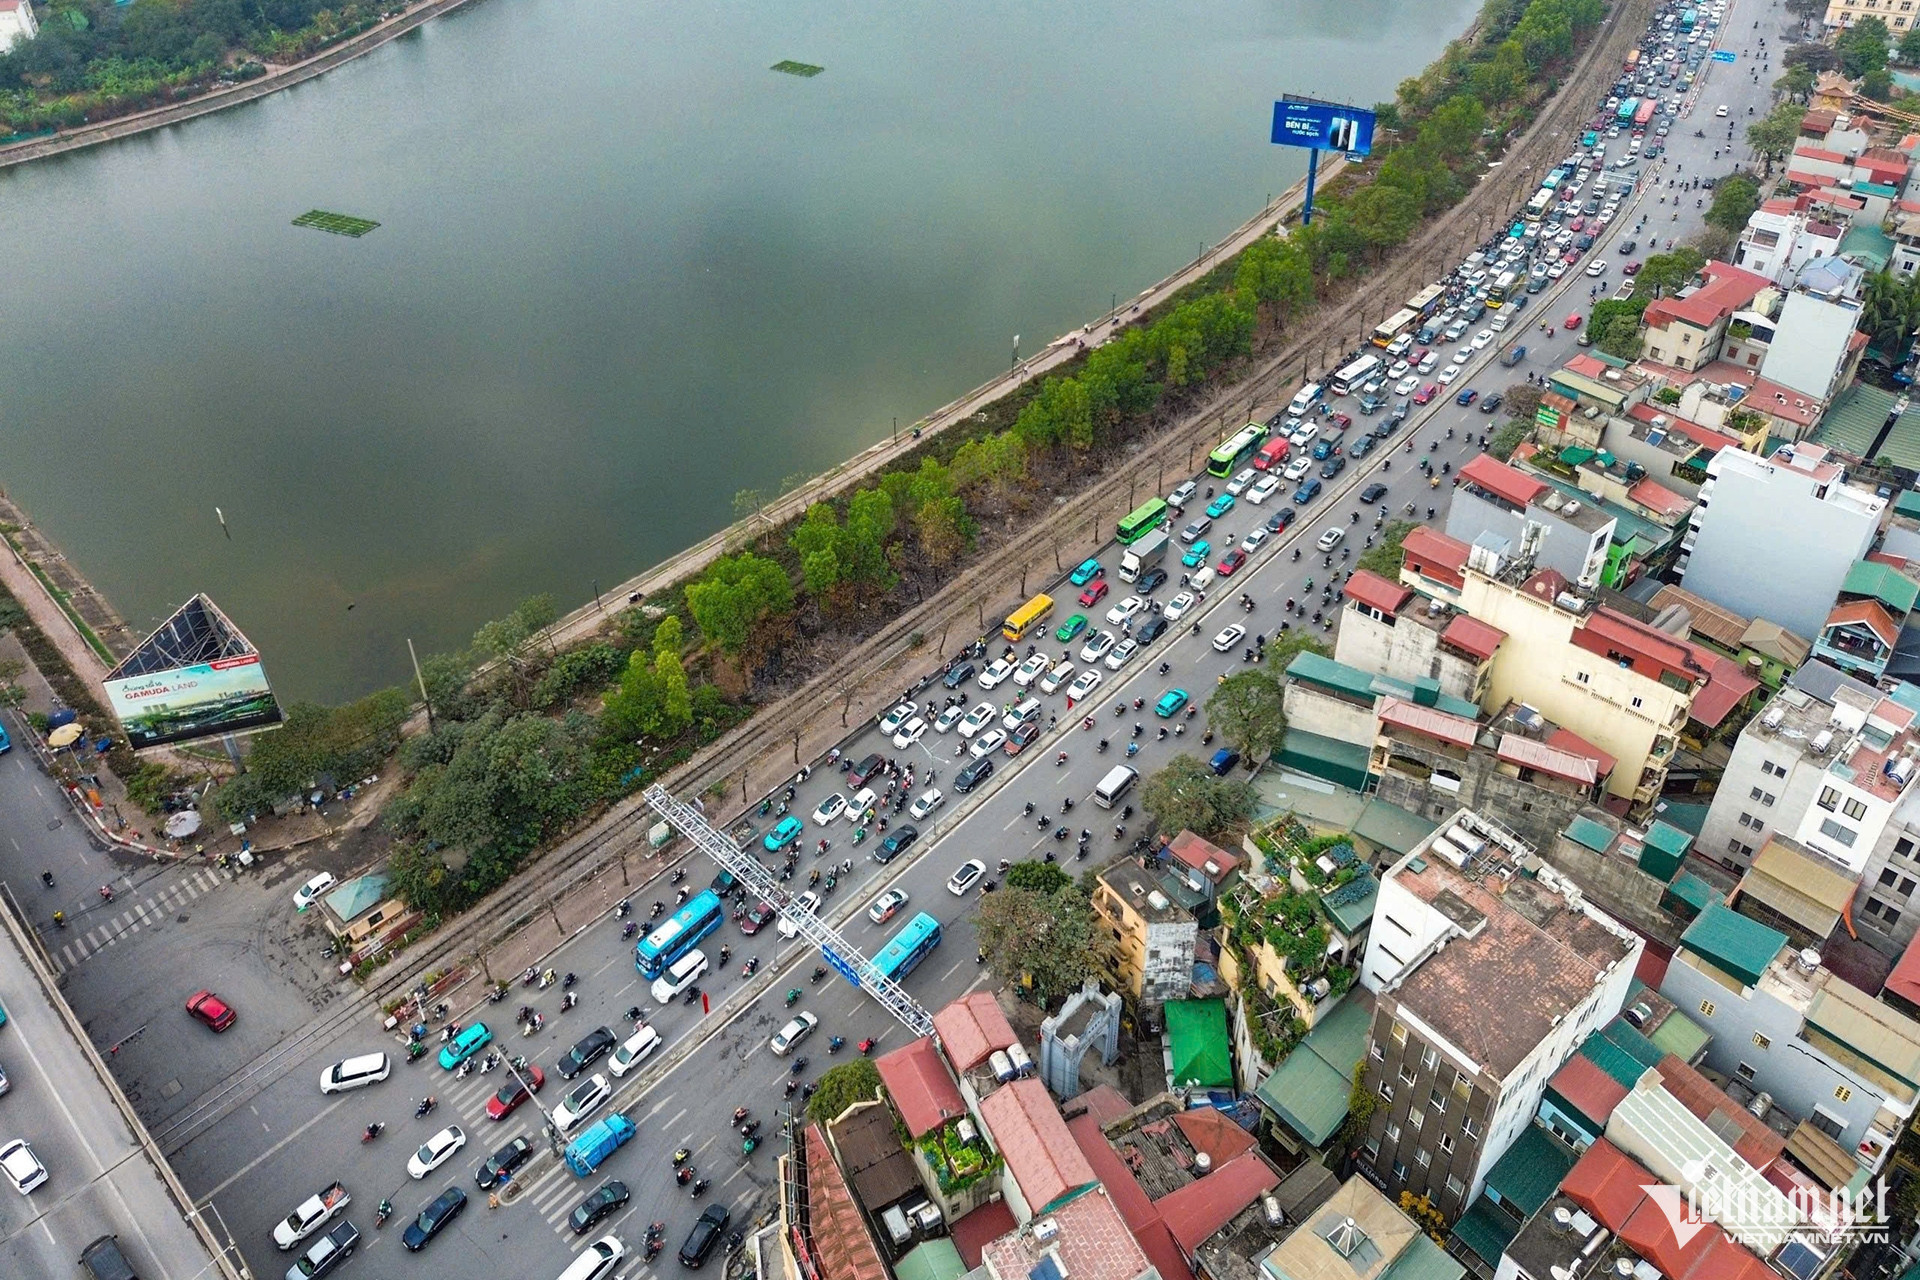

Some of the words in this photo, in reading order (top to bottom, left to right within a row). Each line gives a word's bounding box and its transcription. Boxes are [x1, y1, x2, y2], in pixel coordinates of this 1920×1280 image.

[125, 686, 170, 700] GAMUDA
[172, 680, 198, 692] LAND
[1356, 1159, 1387, 1189] BILLIARDS
